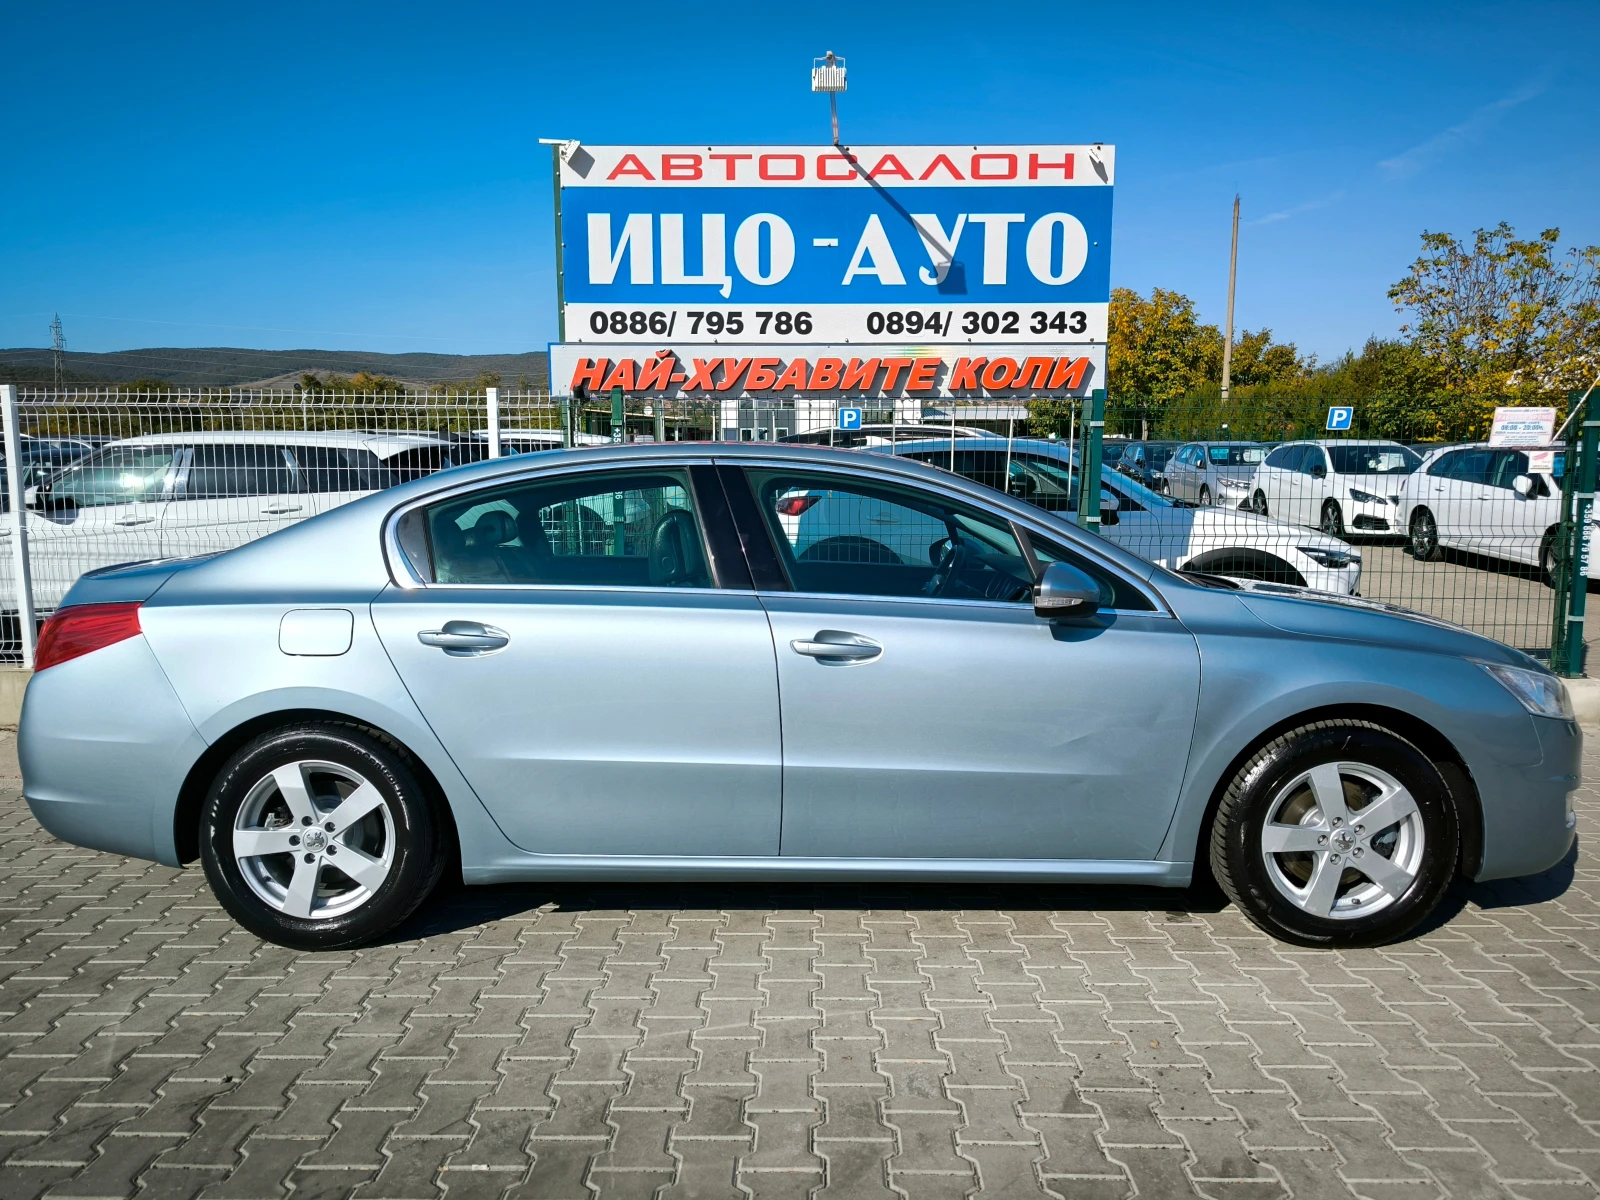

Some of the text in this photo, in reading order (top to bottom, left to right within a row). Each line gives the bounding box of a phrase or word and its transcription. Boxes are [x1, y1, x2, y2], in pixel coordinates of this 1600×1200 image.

[605, 153, 1075, 181] АВТОСАЛОН
[587, 212, 796, 299] ИЦО
[589, 311, 813, 337] 0886/ 795 786
[866, 310, 1088, 337] 0894/ 302 343
[569, 348, 1090, 391] НАЙ-ХУБАВИТЕ КОЛИ
[843, 410, 857, 428] P
[1331, 409, 1348, 427] P
[613, 427, 621, 444] +35
[1580, 554, 1589, 564] 57
